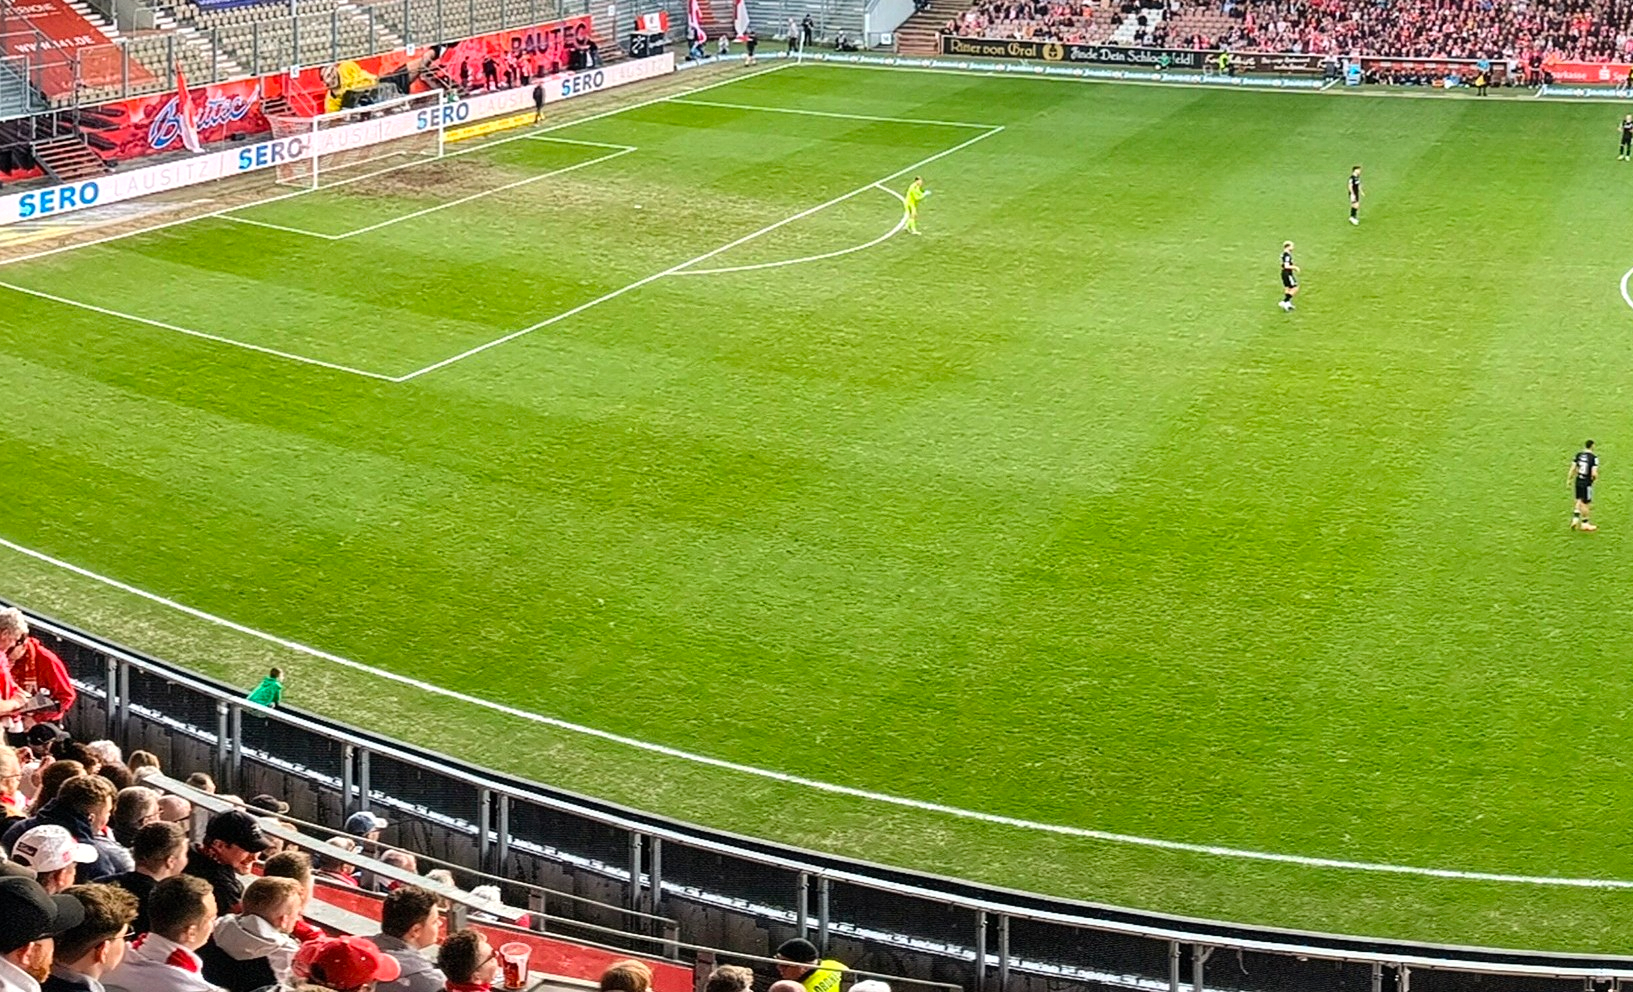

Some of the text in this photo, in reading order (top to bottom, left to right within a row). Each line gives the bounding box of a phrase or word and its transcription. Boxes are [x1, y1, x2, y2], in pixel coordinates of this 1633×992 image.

[1100, 48, 1126, 61] Dein
[561, 70, 604, 97] SERO
[238, 136, 303, 170] SERO
[113, 158, 209, 196] LAUSITZ
[18, 180, 100, 218] SERO
